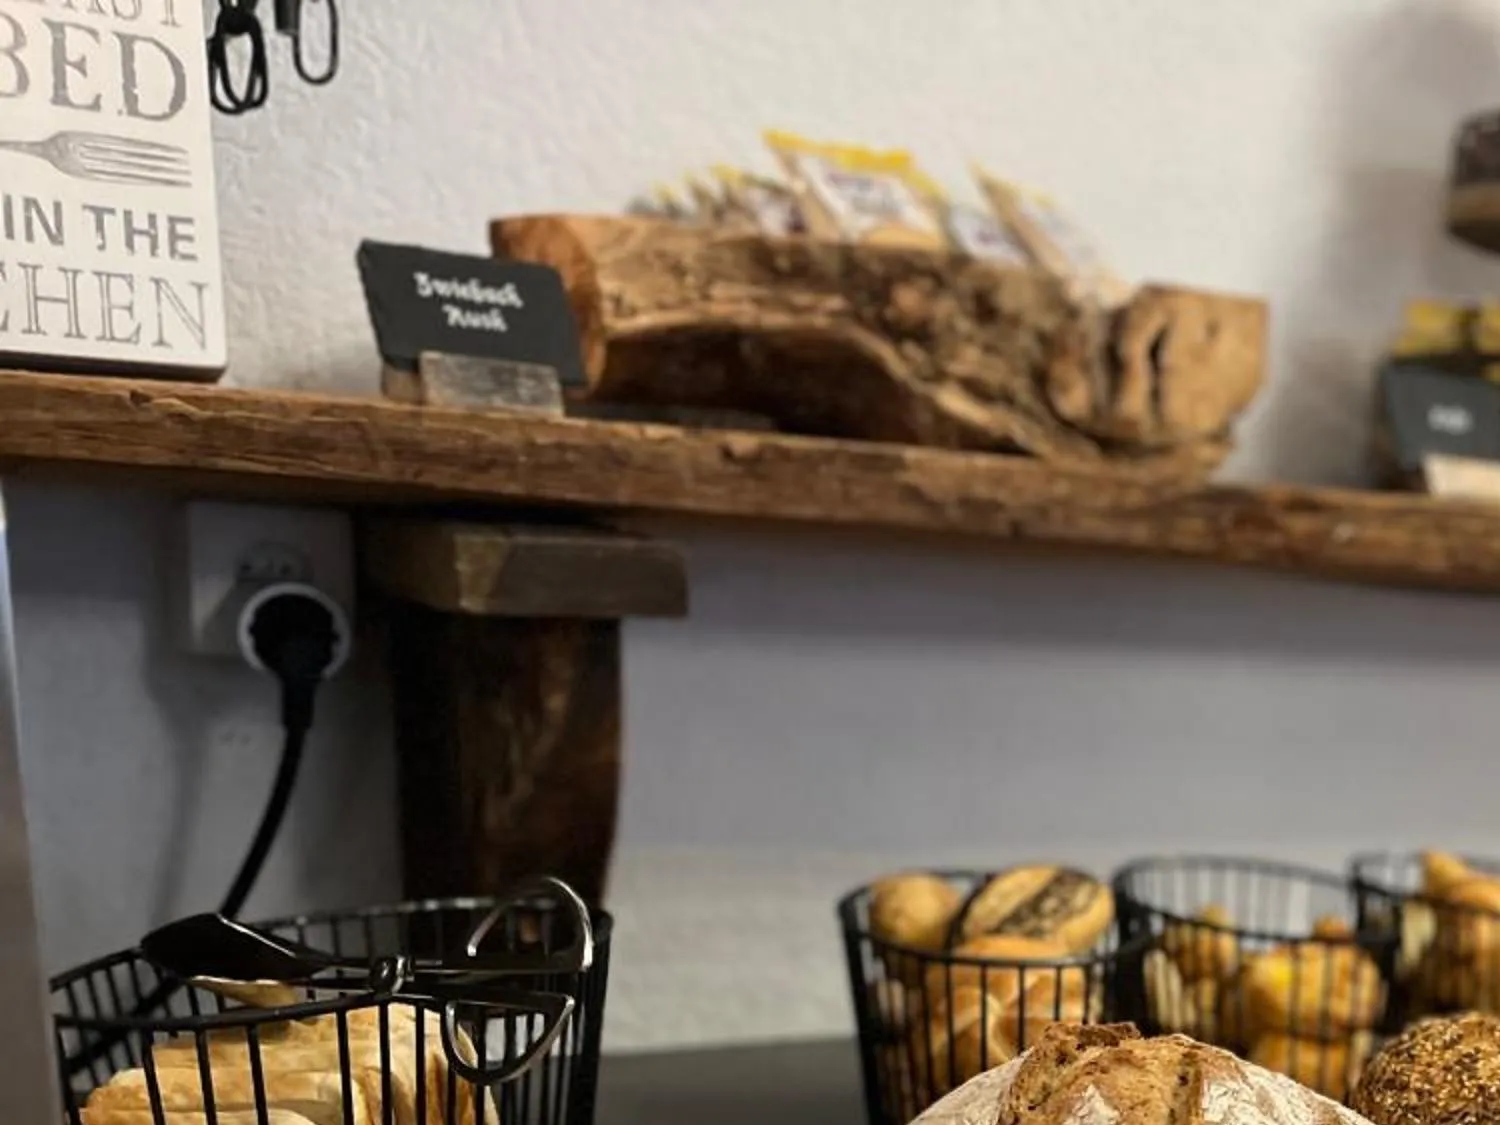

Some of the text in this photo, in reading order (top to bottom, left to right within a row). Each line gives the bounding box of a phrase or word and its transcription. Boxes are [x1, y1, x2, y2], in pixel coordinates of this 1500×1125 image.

[2, 193, 198, 262] IN THE
[0, 260, 209, 350] HEN
